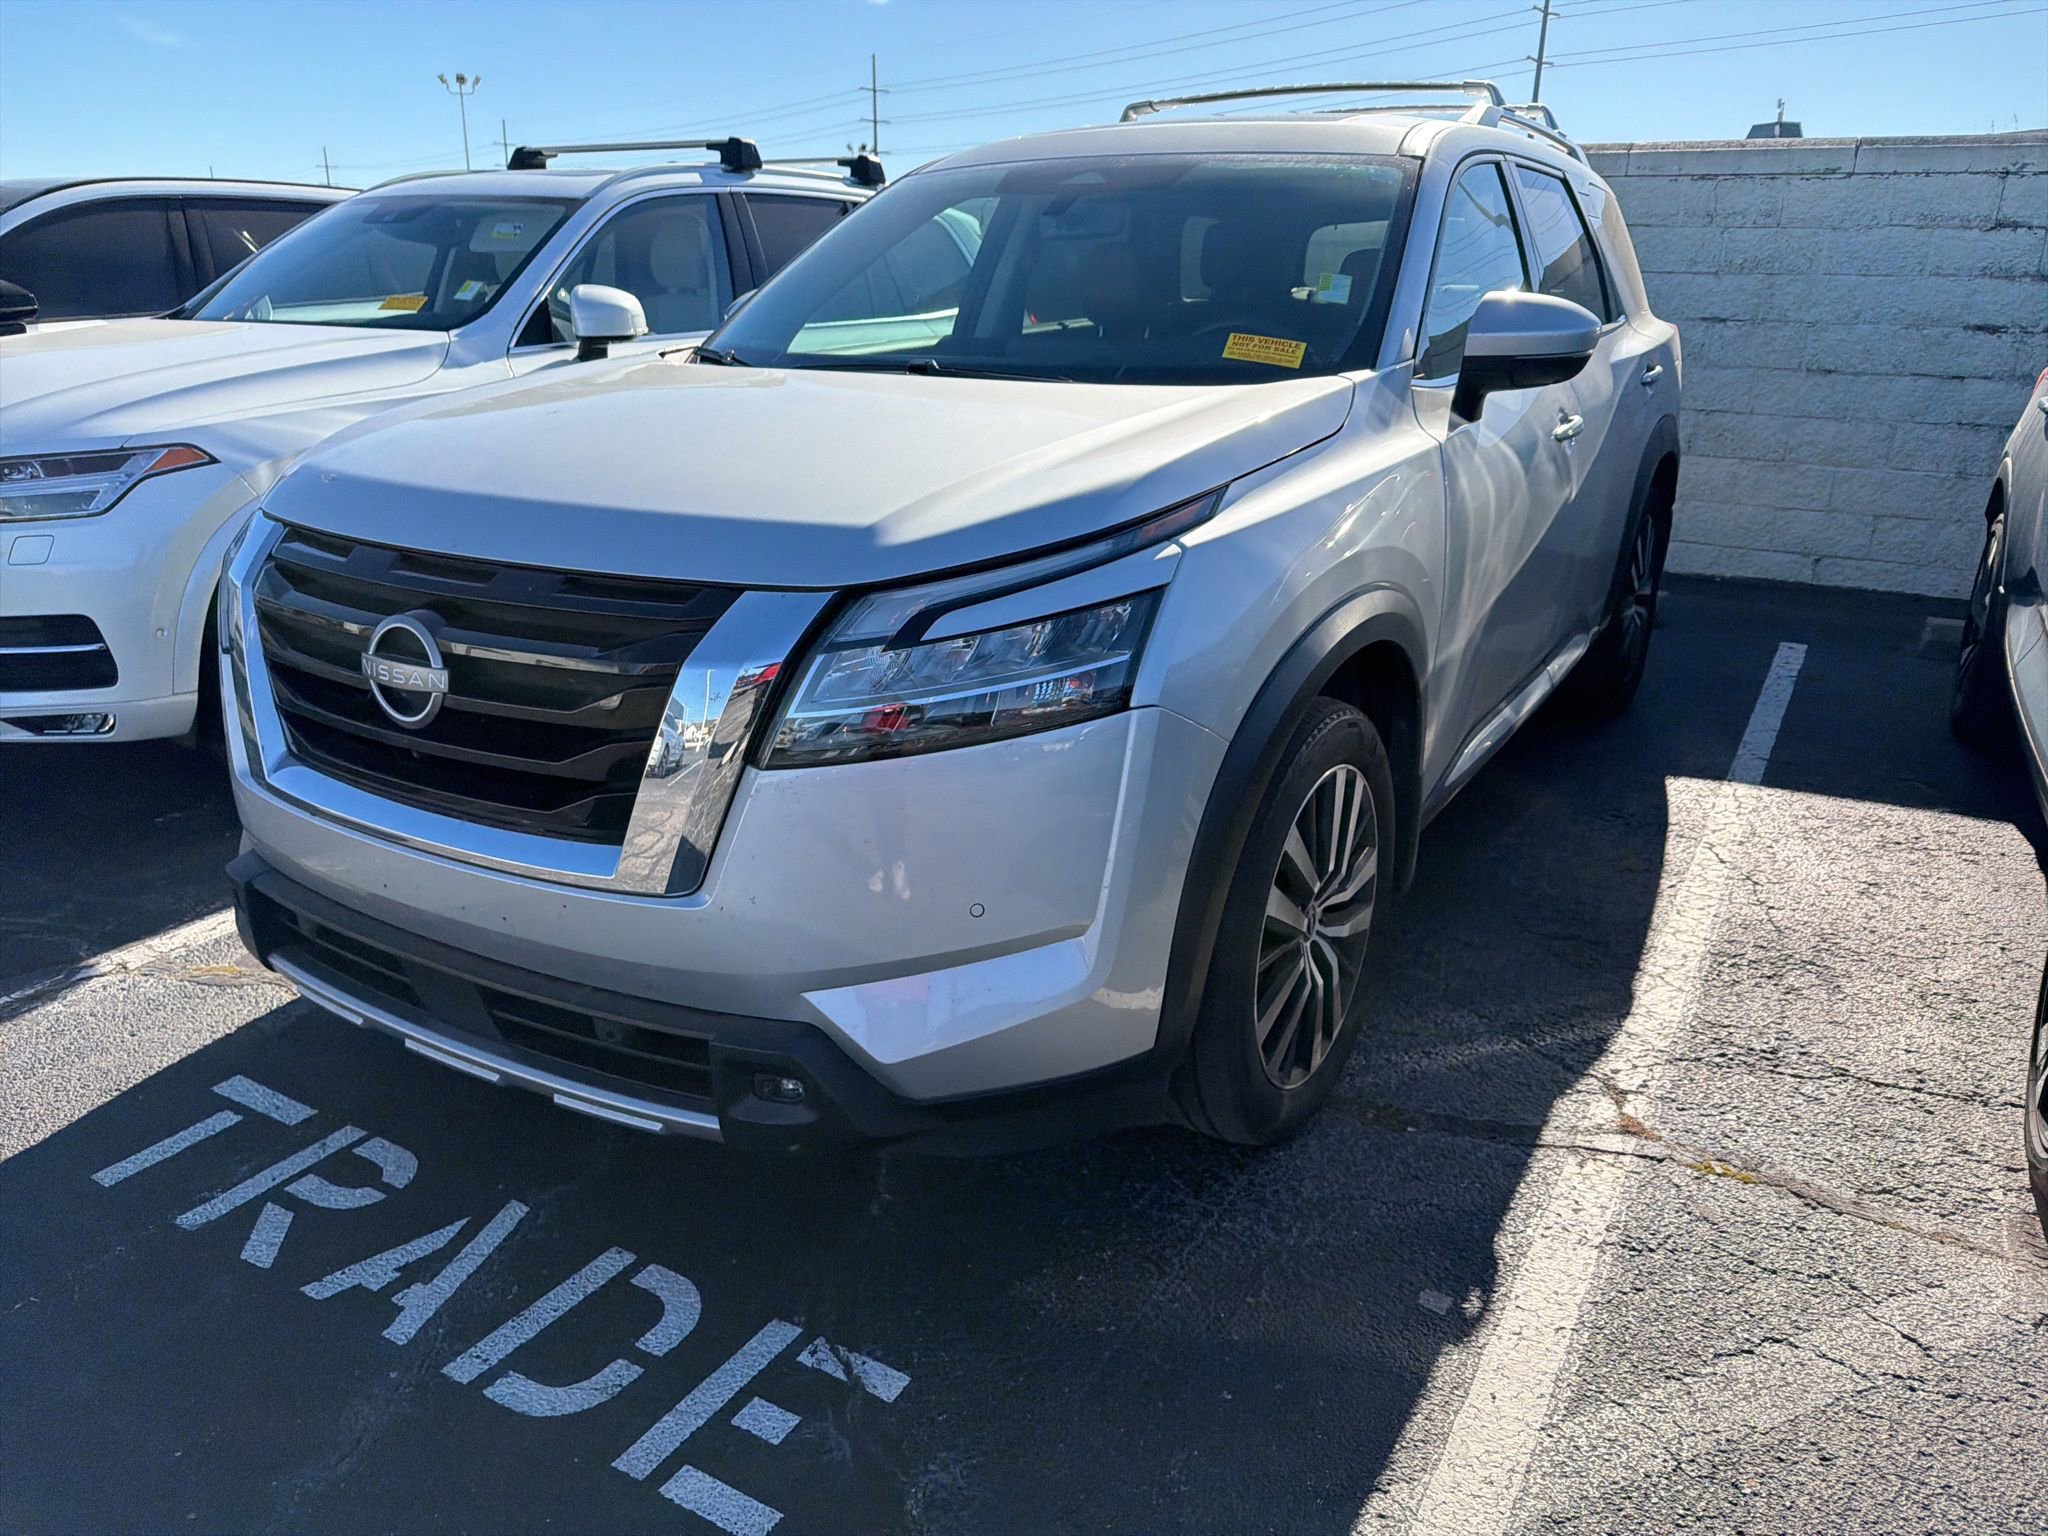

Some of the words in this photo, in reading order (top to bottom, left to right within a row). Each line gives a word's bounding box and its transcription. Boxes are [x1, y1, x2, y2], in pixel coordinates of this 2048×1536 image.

[1232, 335, 1255, 343] THIS
[1258, 337, 1302, 350] VEHICLE
[1252, 343, 1272, 351] FOR
[1273, 346, 1298, 355] SALE
[362, 658, 445, 689] NISSAN
[90, 1074, 911, 1536] TRADE
